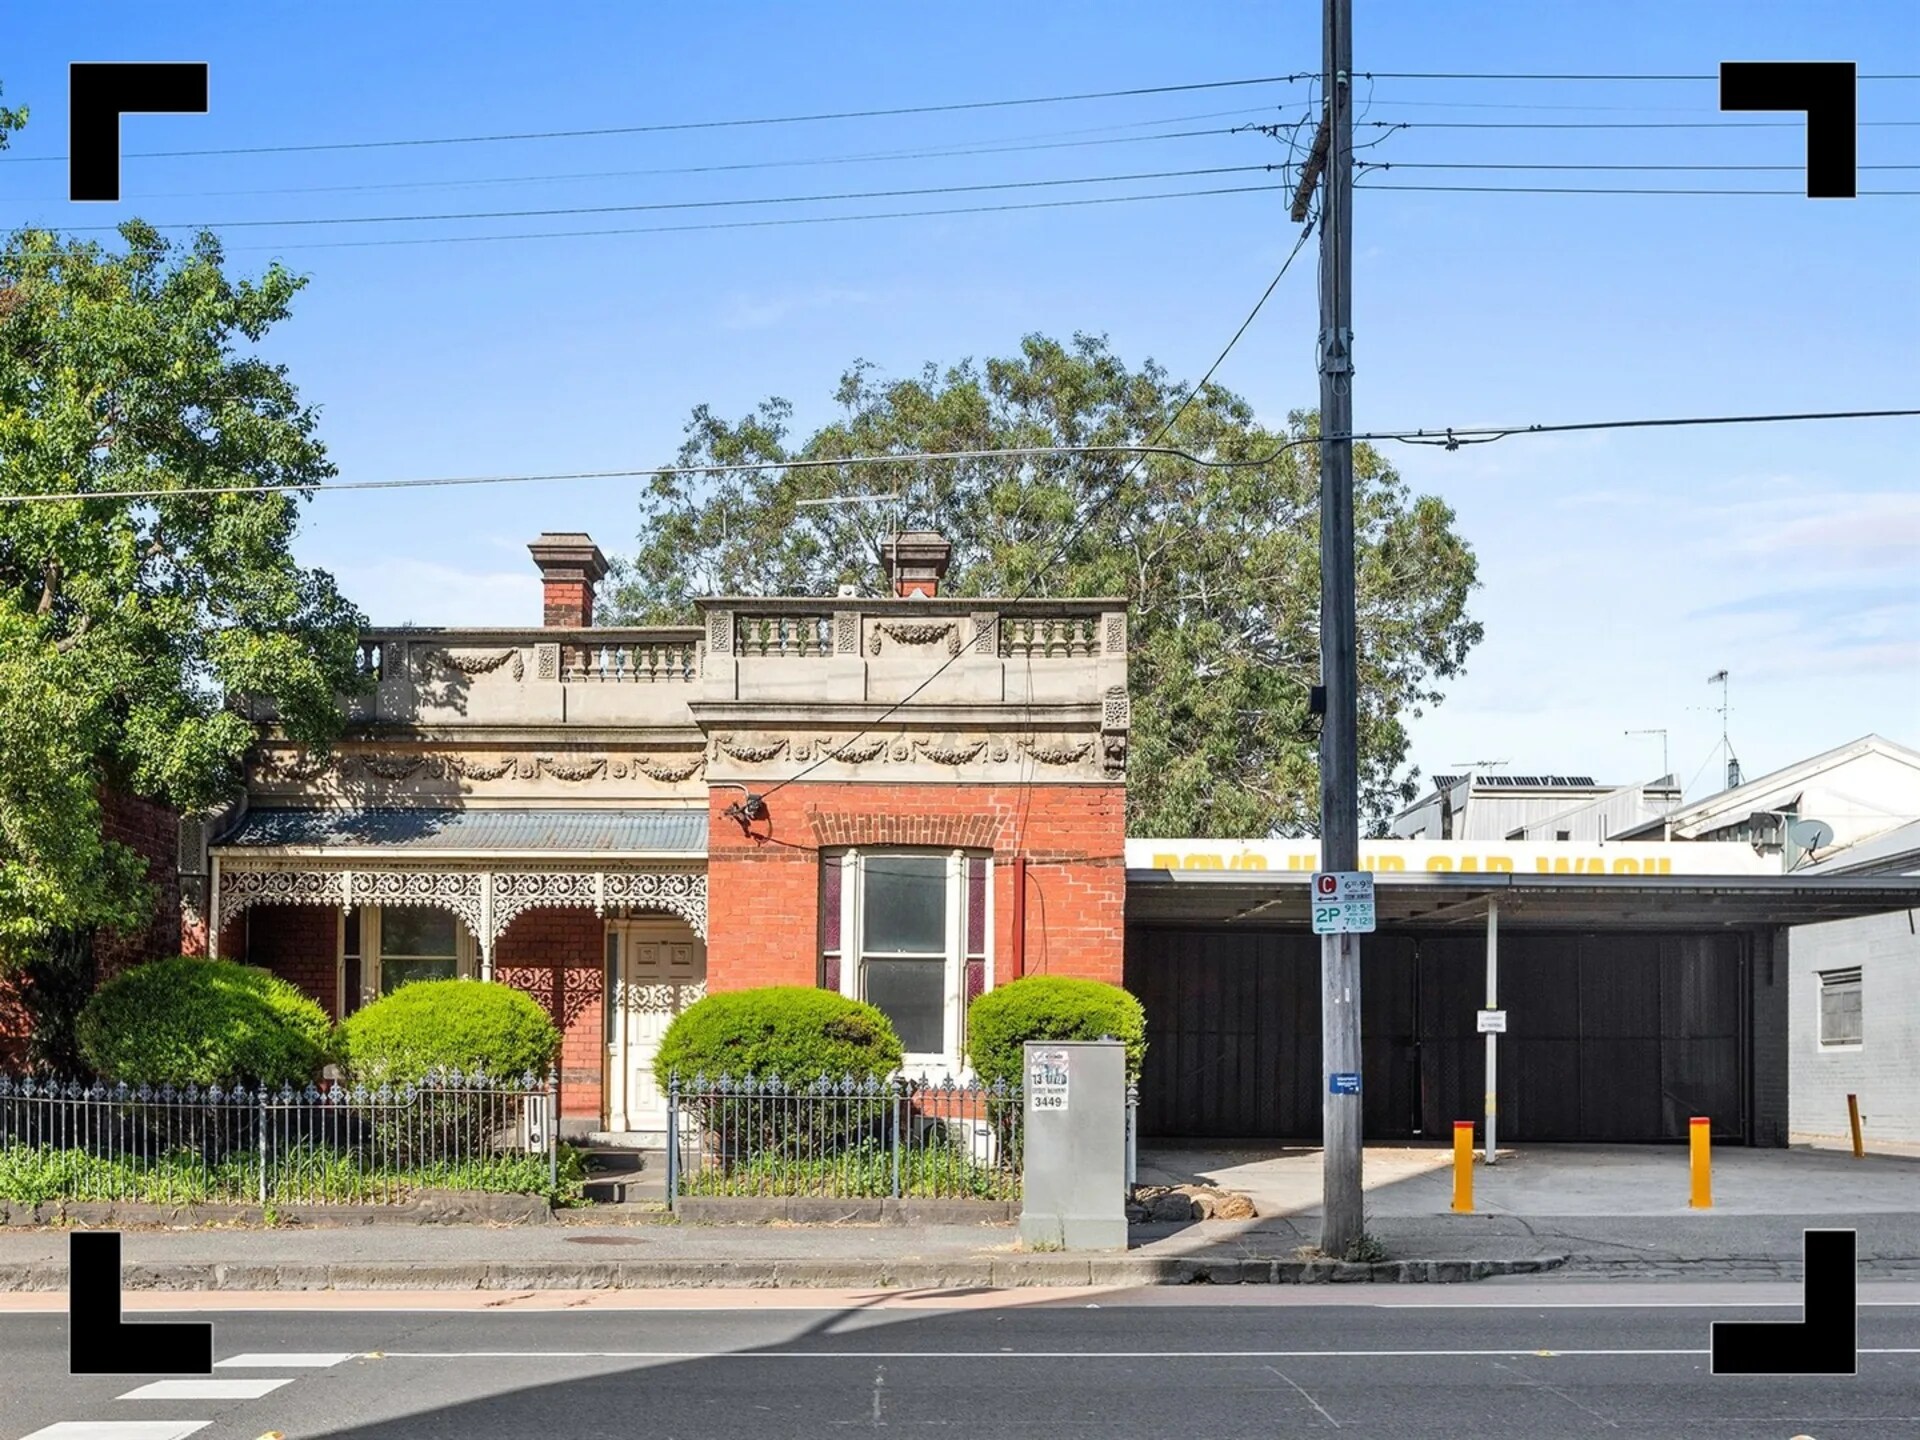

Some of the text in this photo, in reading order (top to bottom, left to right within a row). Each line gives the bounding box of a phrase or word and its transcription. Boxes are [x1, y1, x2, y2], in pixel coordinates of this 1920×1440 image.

[1323, 876, 1332, 893] C
[1316, 908, 1341, 923] 2P
[1035, 1097, 1062, 1107] 3449
